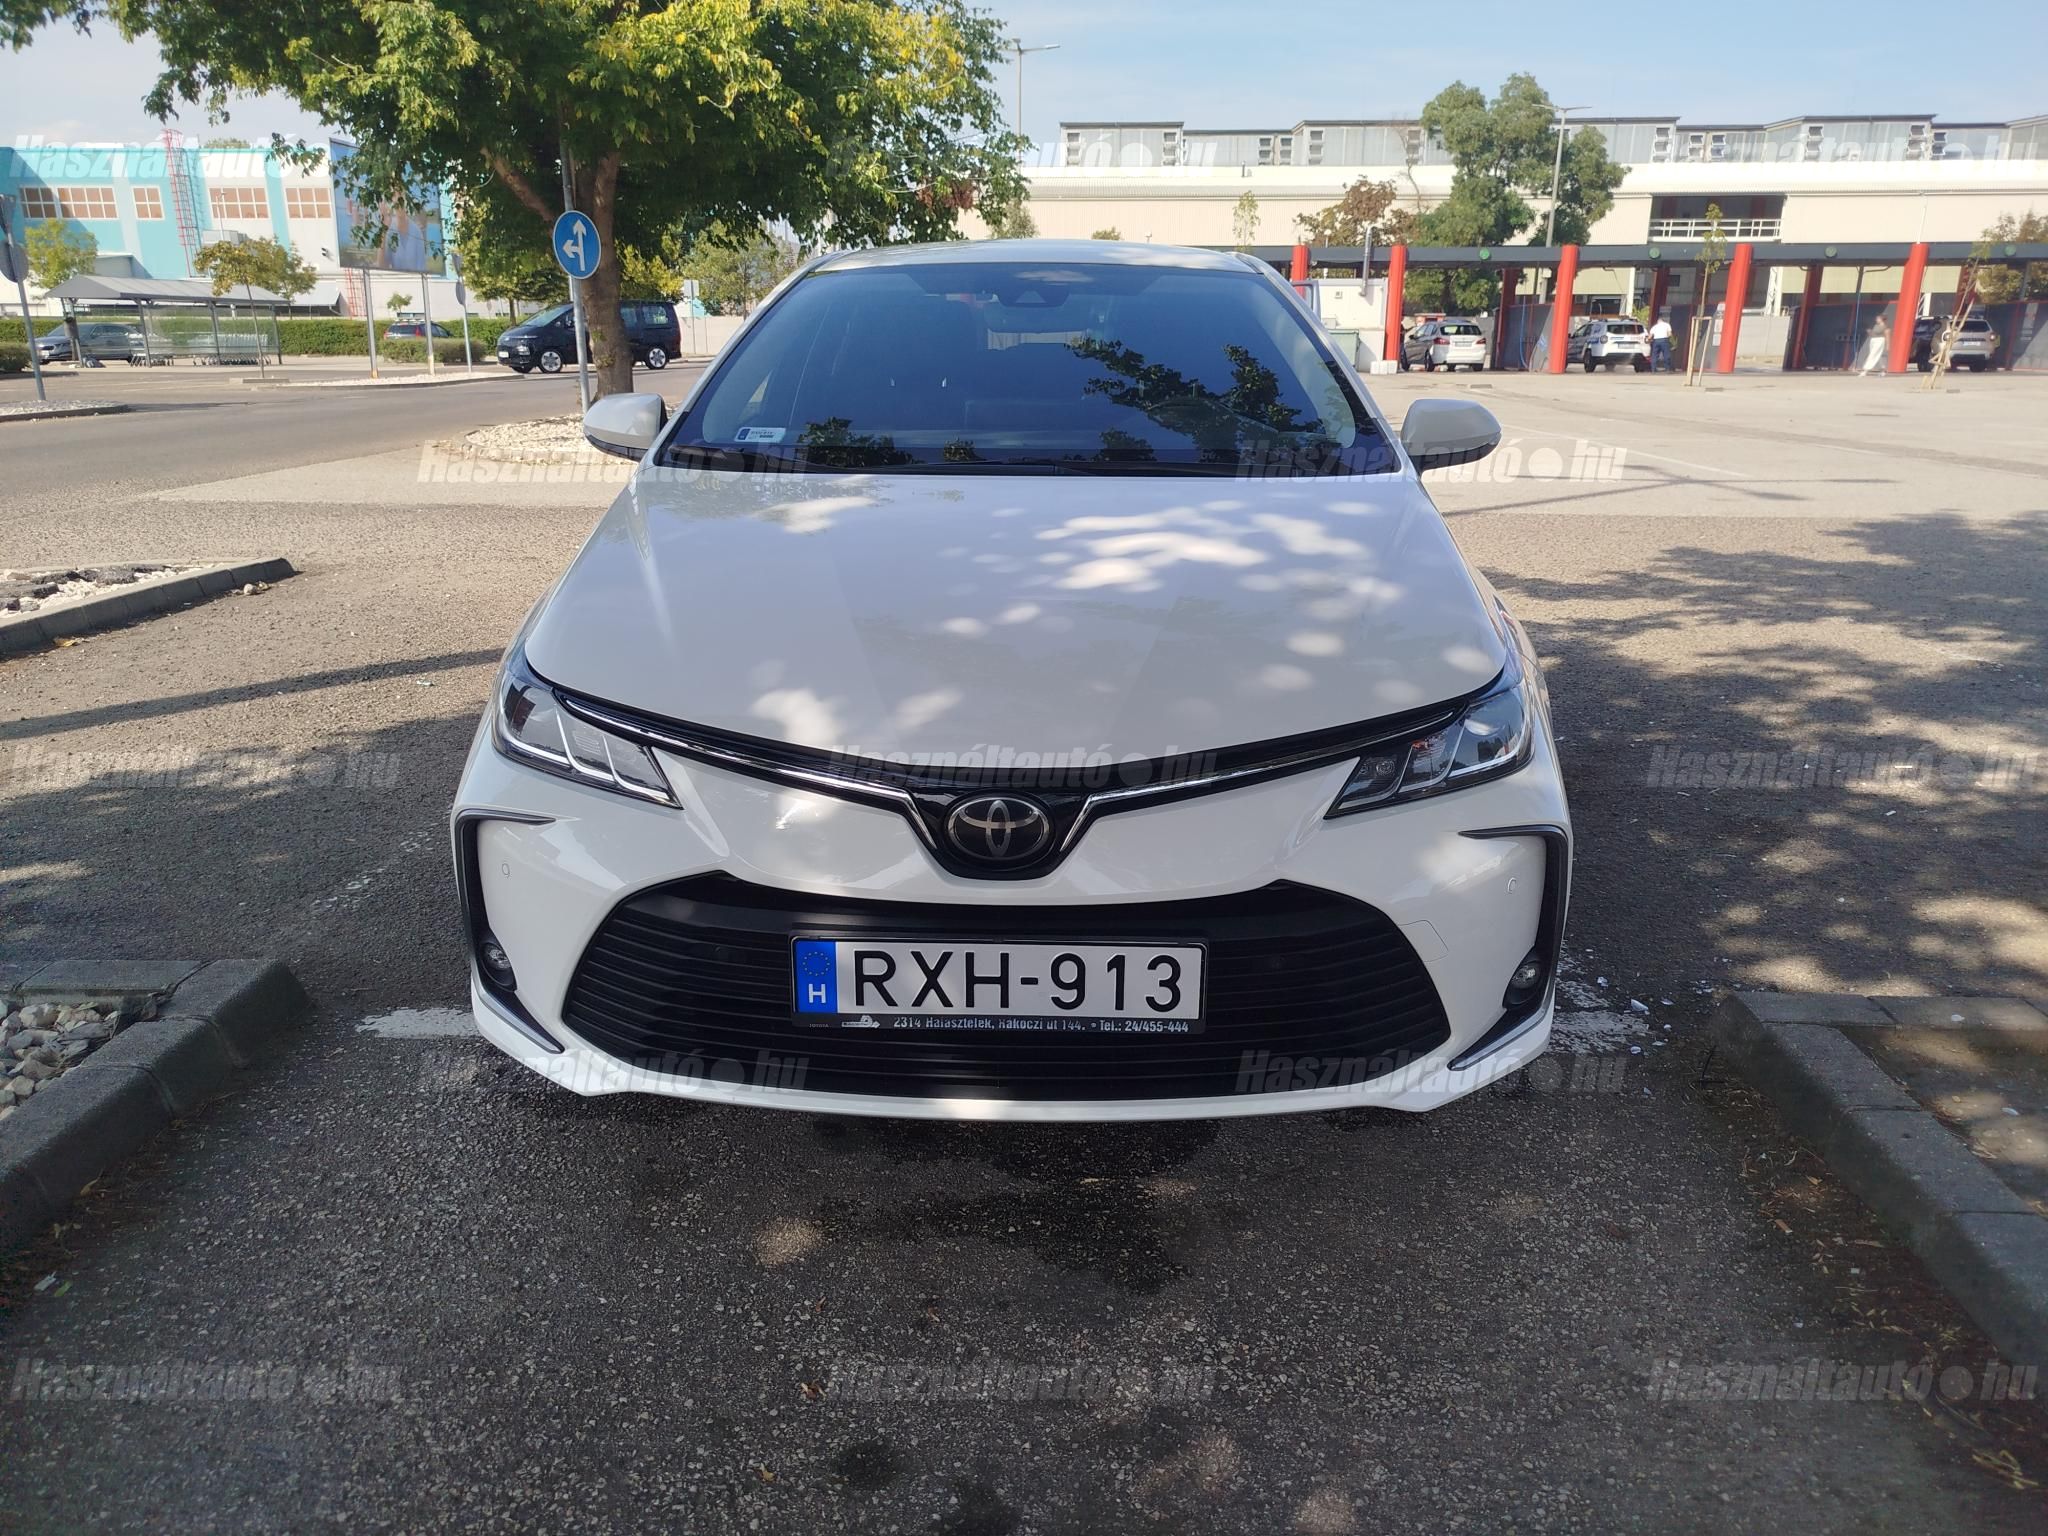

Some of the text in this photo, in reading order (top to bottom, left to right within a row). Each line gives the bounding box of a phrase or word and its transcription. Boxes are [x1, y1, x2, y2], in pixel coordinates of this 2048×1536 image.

[853, 949, 1182, 1013] RXH-913
[807, 983, 827, 1004] H
[893, 1016, 922, 1028] 2314
[1099, 1019, 1122, 1032] Tel.:
[1124, 1020, 1190, 1033] 24/455-444
